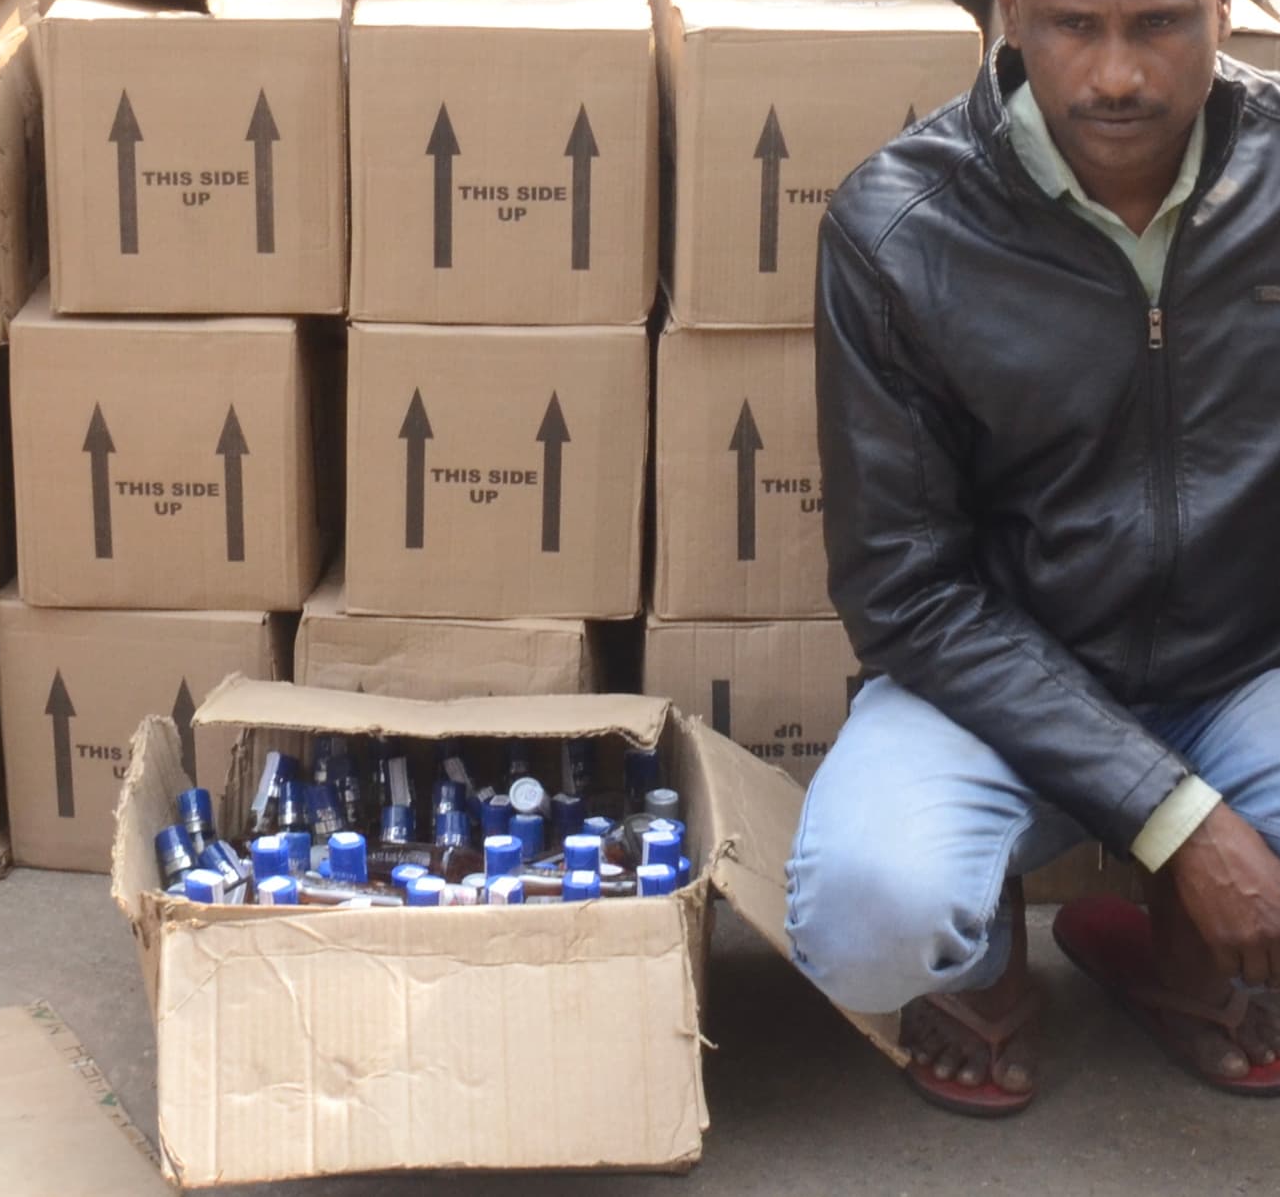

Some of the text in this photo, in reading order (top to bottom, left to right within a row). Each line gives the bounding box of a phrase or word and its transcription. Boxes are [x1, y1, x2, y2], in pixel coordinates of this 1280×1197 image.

[142, 171, 249, 187] THIS SIDE
[182, 191, 211, 207] UP
[458, 185, 567, 201] THIS SIDE
[497, 206, 527, 222] UP
[430, 468, 538, 485] THIS SIDE
[115, 481, 220, 497] THIS SIDE
[761, 478, 812, 494] THIS
[469, 489, 499, 504] UP
[154, 501, 183, 516] UP
[774, 723, 803, 739] UP
[75, 744, 123, 761] THIS
